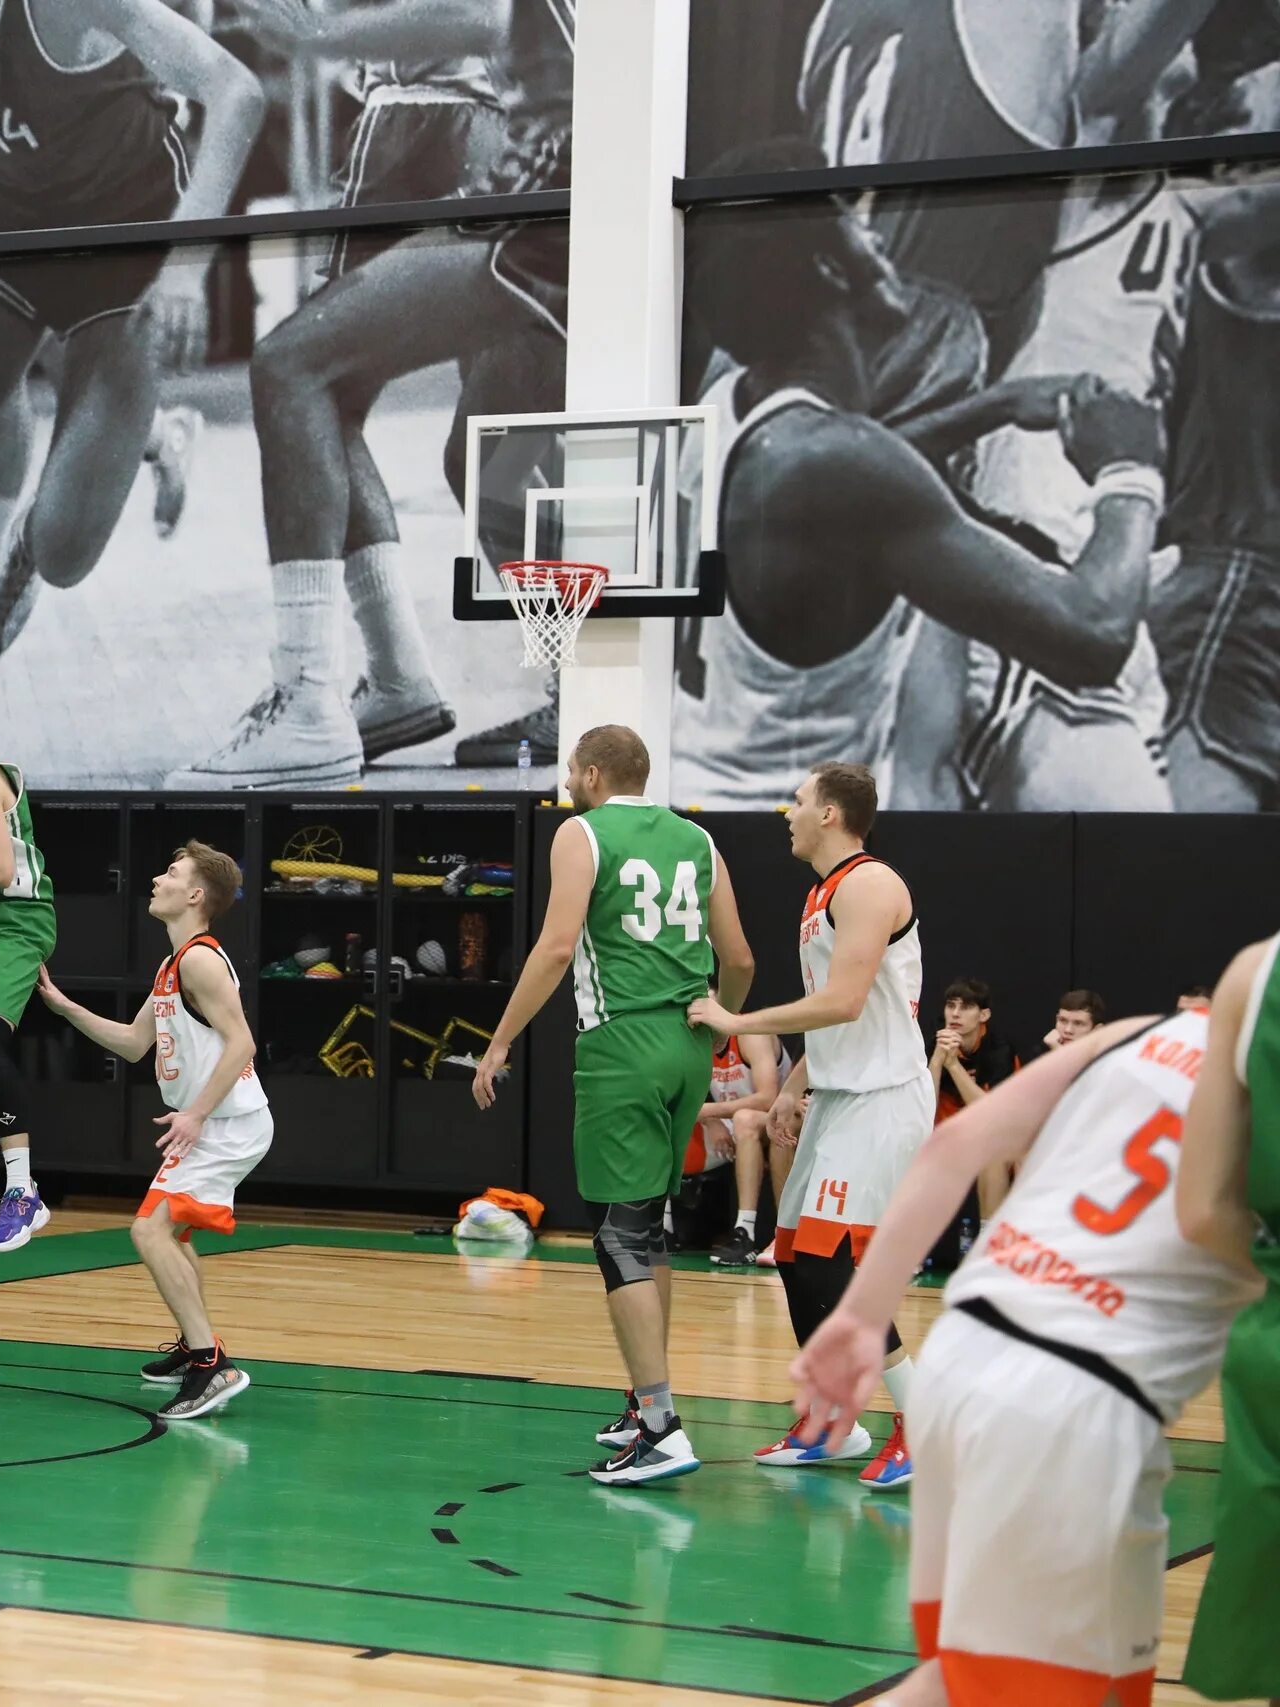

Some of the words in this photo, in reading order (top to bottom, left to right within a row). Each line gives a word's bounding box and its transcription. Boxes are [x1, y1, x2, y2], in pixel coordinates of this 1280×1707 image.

[619, 858, 703, 942] 34
[815, 1178, 848, 1216] 14
[1071, 1106, 1184, 1236] 5
